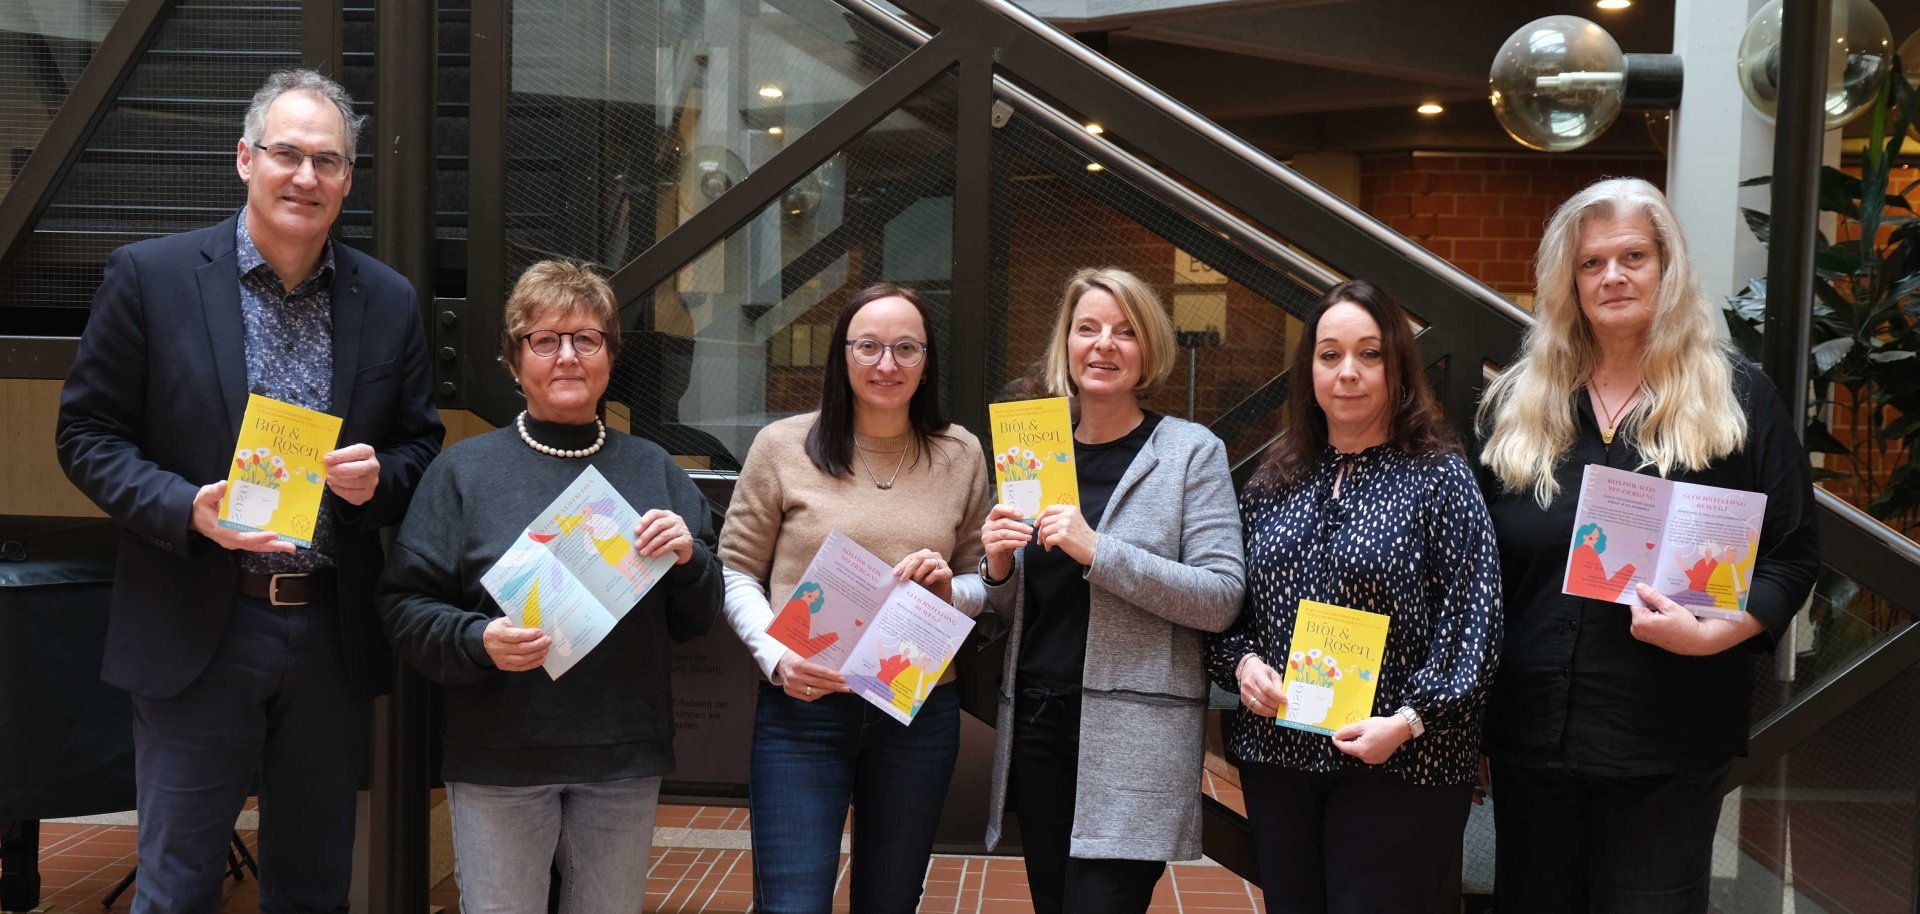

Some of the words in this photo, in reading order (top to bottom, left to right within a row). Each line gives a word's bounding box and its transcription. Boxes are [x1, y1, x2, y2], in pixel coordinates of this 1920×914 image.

[1029, 420, 1038, 431] &
[288, 427, 300, 440] &
[1018, 430, 1062, 446] Rosen
[272, 435, 321, 463] Rosen
[1339, 628, 1349, 640] &
[1324, 637, 1371, 661] Rosen
